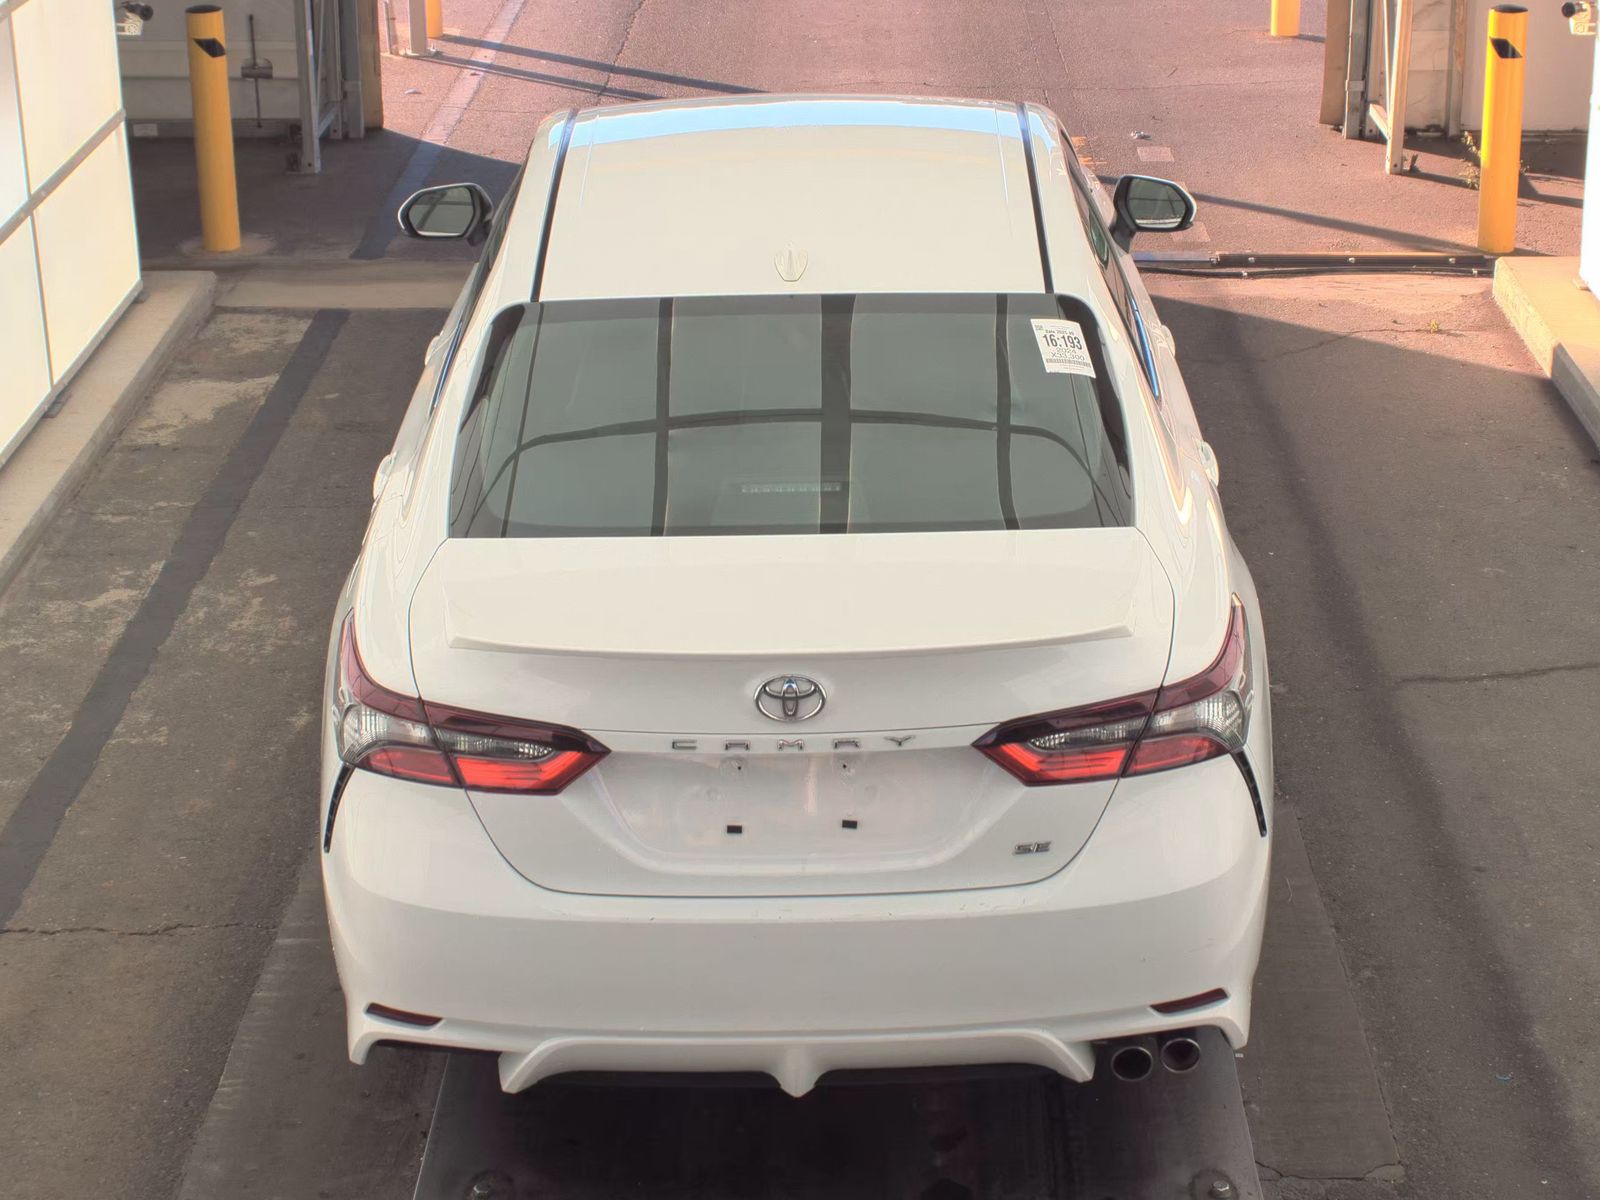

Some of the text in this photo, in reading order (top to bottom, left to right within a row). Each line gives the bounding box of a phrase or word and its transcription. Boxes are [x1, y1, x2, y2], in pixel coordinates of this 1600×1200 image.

[1043, 334, 1083, 350] 16:193
[671, 735, 917, 751] CAMRY
[1012, 841, 1051, 855] SE
